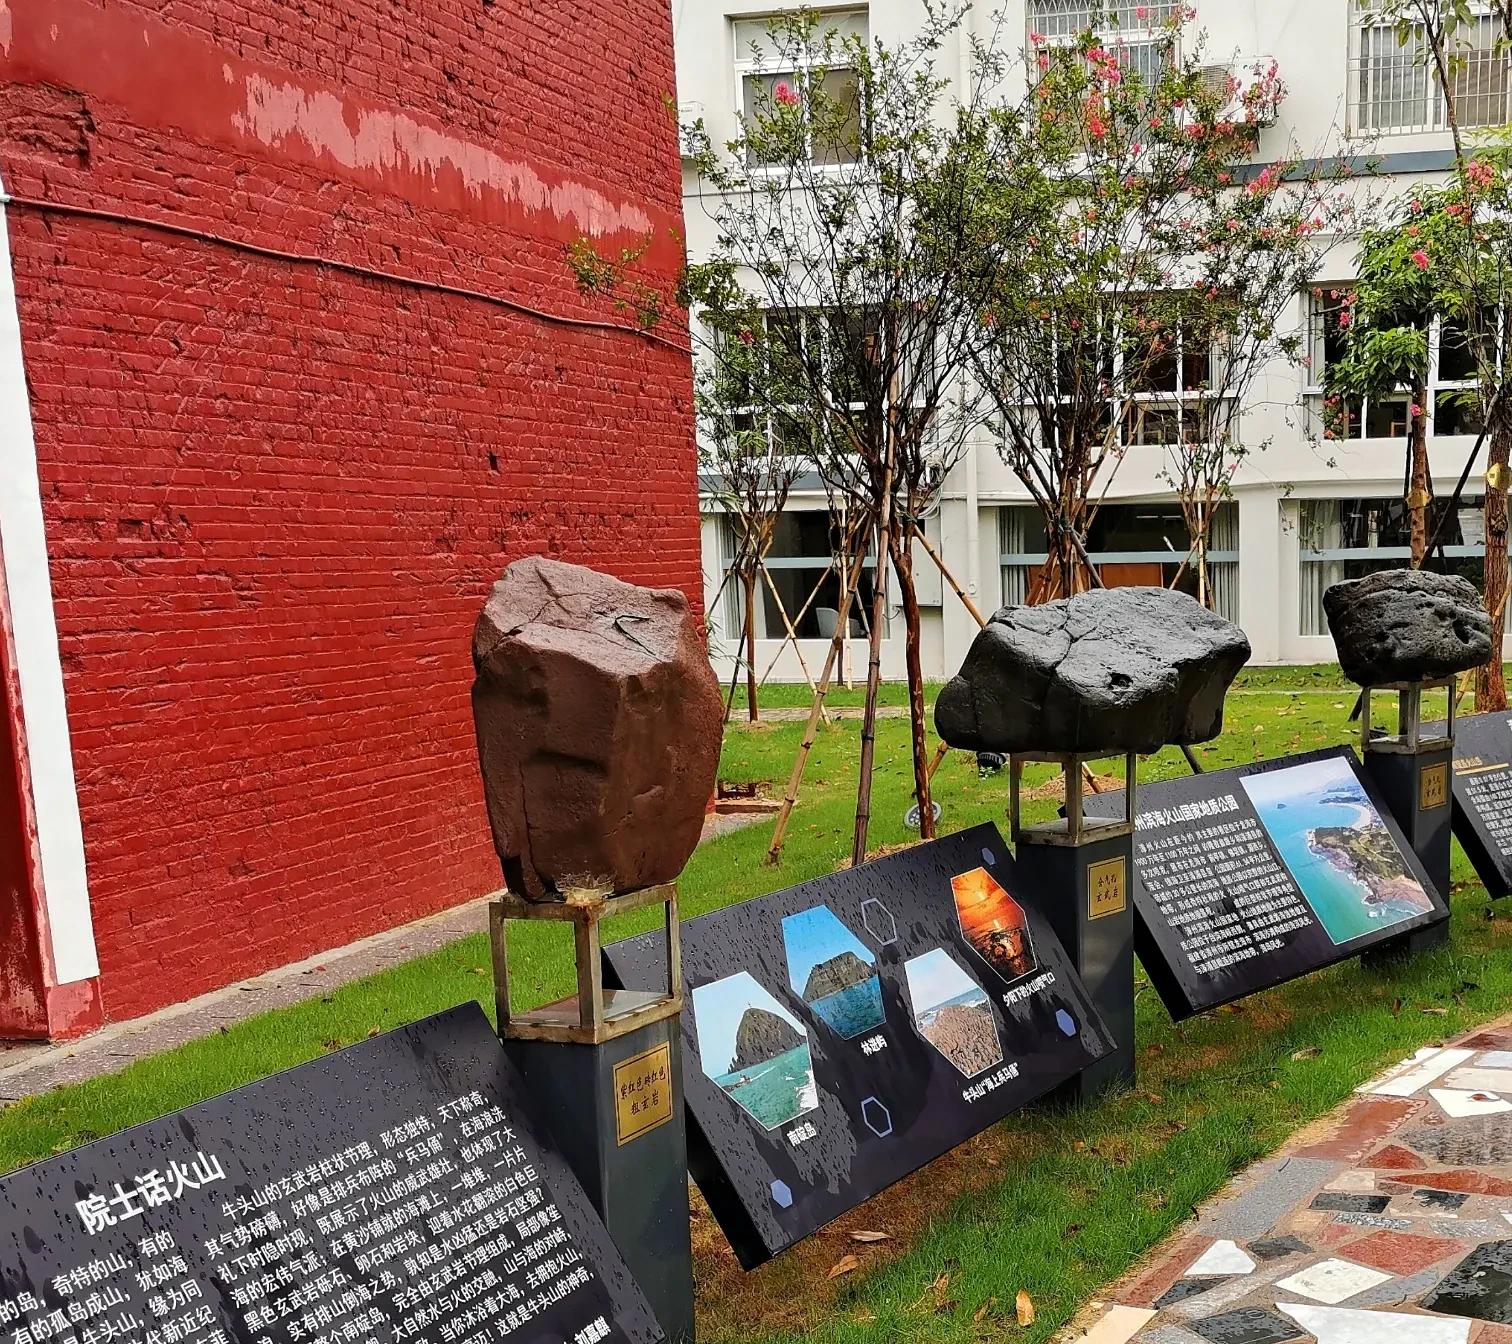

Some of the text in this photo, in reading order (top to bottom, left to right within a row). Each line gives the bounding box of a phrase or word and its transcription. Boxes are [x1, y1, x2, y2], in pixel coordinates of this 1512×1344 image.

[1134, 794, 1239, 831] 州滨海火山国家地质公园
[1003, 972, 1056, 1007] 夕阳下的火山喷气口
[75, 1151, 227, 1235] 院士话火山
